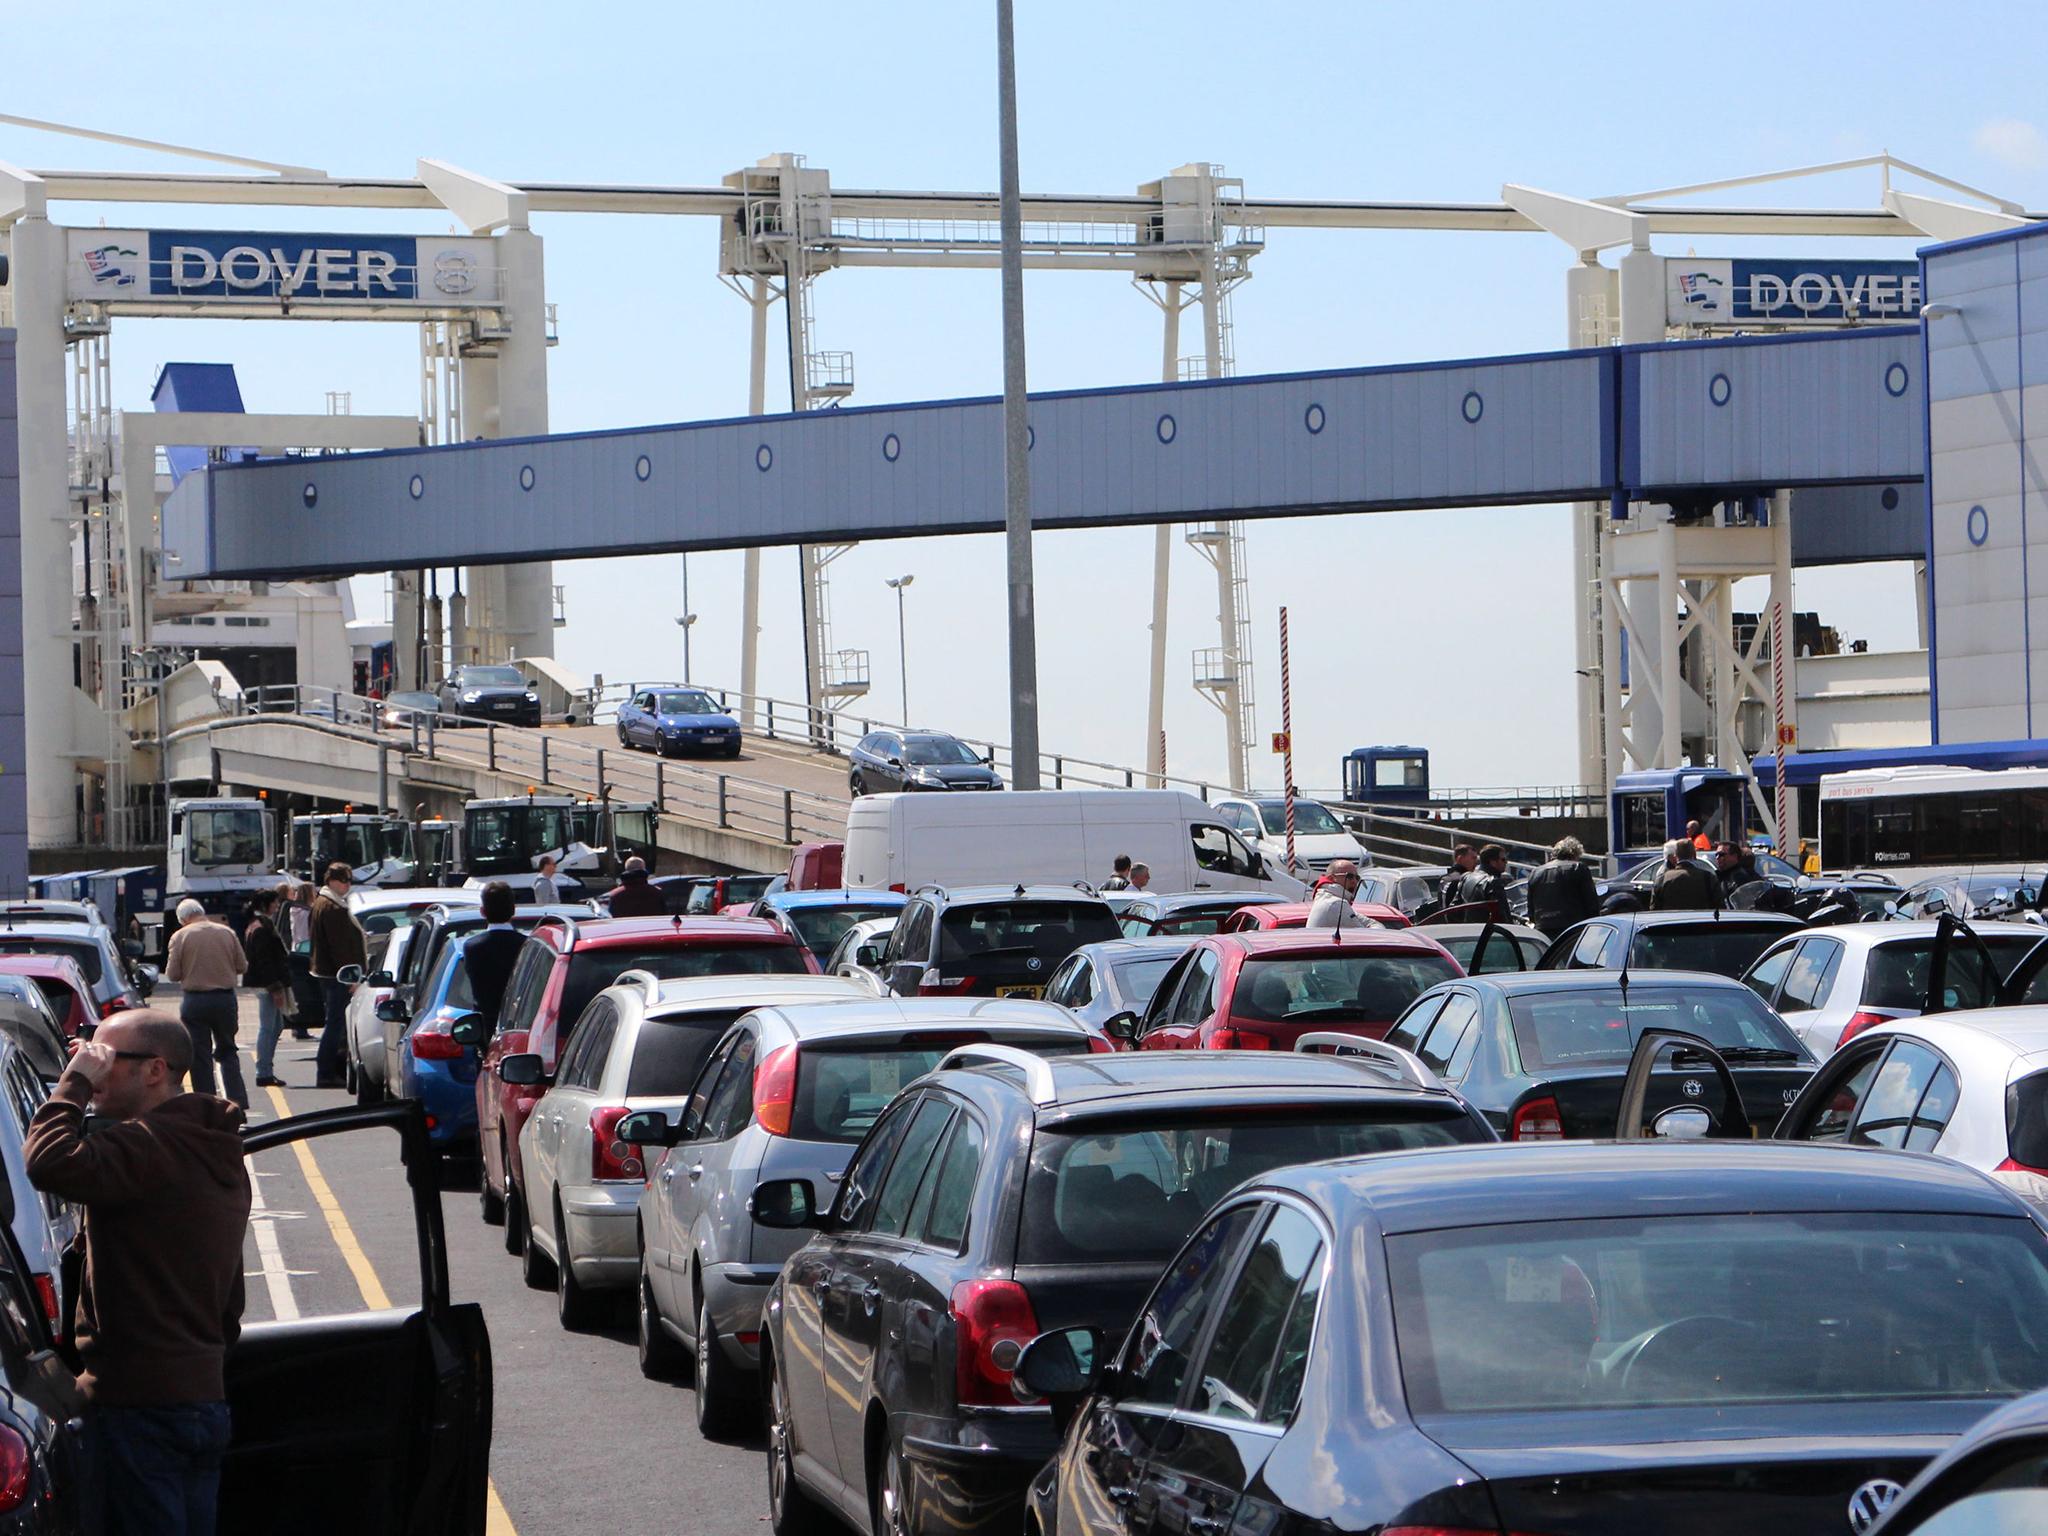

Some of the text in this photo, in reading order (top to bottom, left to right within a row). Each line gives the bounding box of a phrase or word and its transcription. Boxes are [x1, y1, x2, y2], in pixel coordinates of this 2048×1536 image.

[170, 246, 478, 294] DOVER 8
[247, 865, 253, 873] 6
